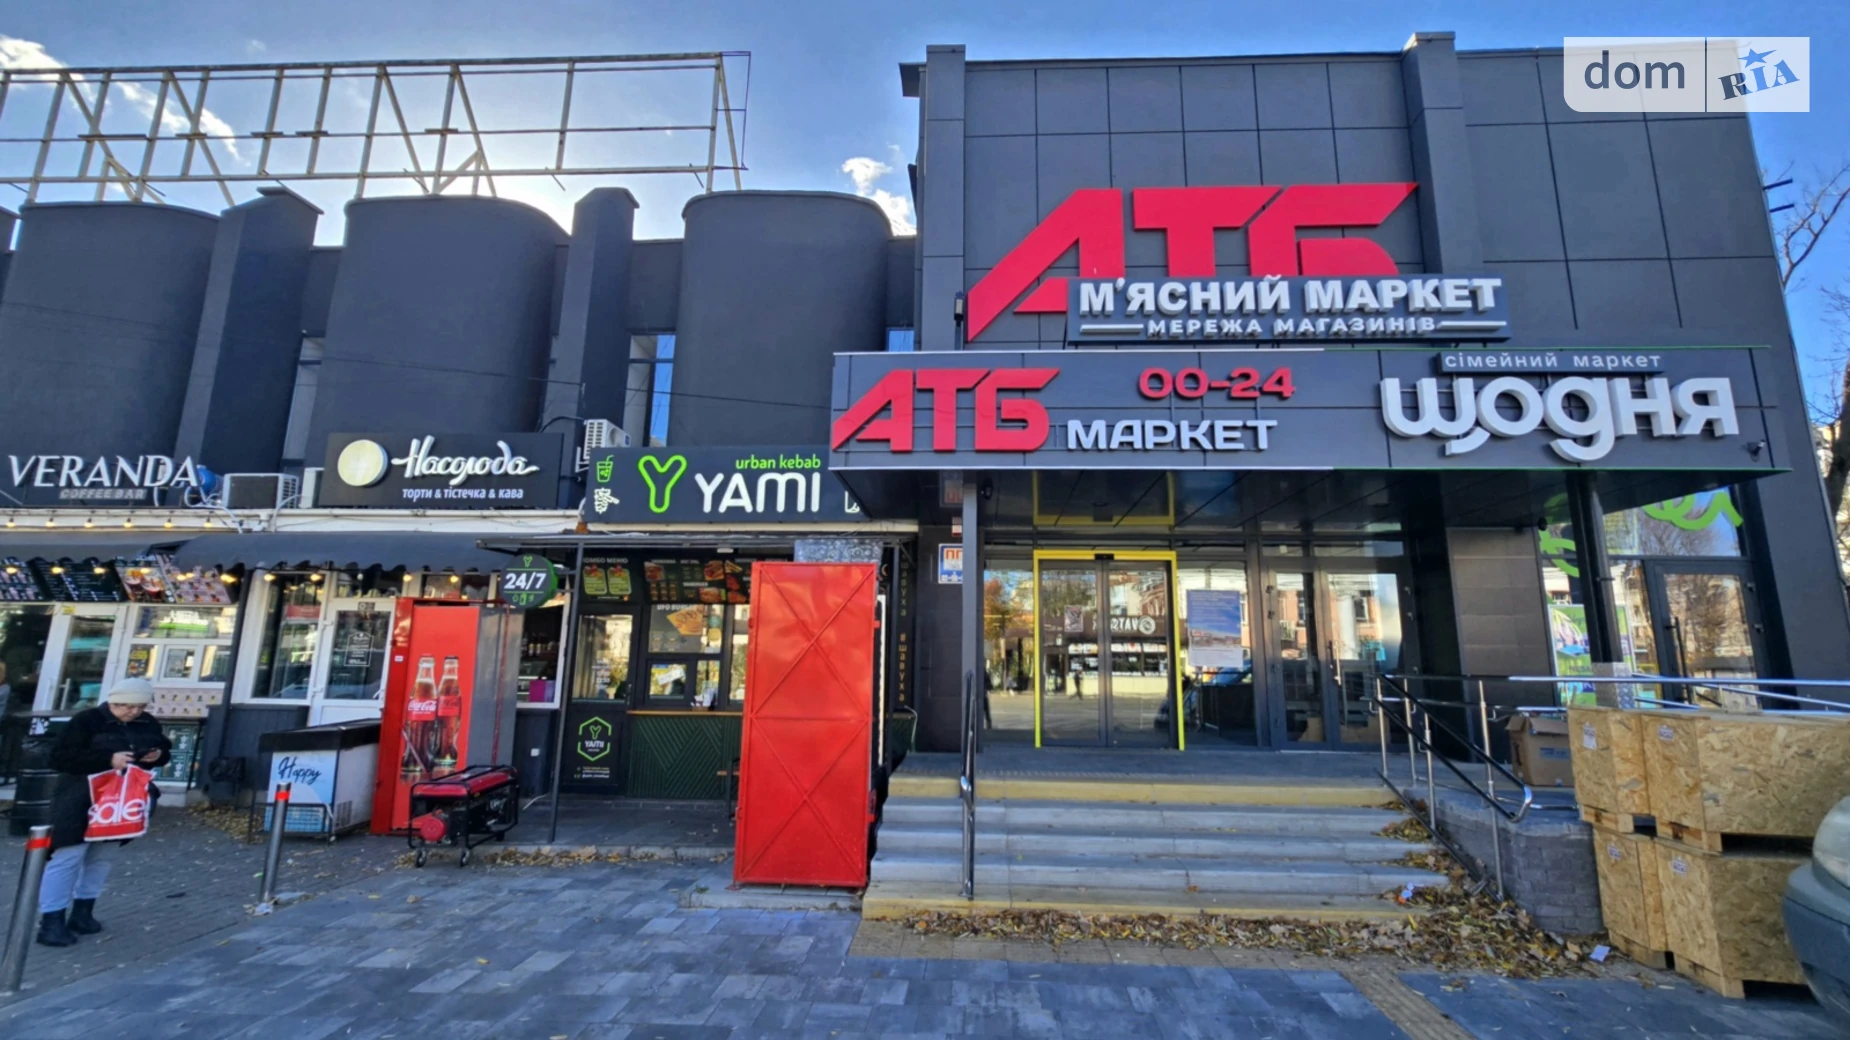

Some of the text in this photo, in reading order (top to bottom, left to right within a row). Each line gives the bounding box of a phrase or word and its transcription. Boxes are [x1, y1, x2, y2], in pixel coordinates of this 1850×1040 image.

[967, 183, 1418, 343] АТБ
[1305, 277, 1503, 311] МАРКЕТ
[1147, 315, 1438, 336] МЕРЕЖА МАГАЗИНІВ
[1445, 351, 1662, 370] сімейний маркет
[1139, 367, 1296, 399] 00-24
[830, 368, 1060, 452] АТБ
[1066, 419, 1279, 451] МАРКЕТ
[8, 455, 198, 488] VERANDA
[735, 454, 822, 470] urban kebab
[59, 488, 147, 500] COFFEE BAR
[402, 487, 525, 502] торти & тістечка & кава
[694, 471, 822, 513] YAMI
[502, 571, 548, 591] 24/7
[584, 740, 605, 749] YAMI
[277, 755, 322, 786] Happy
